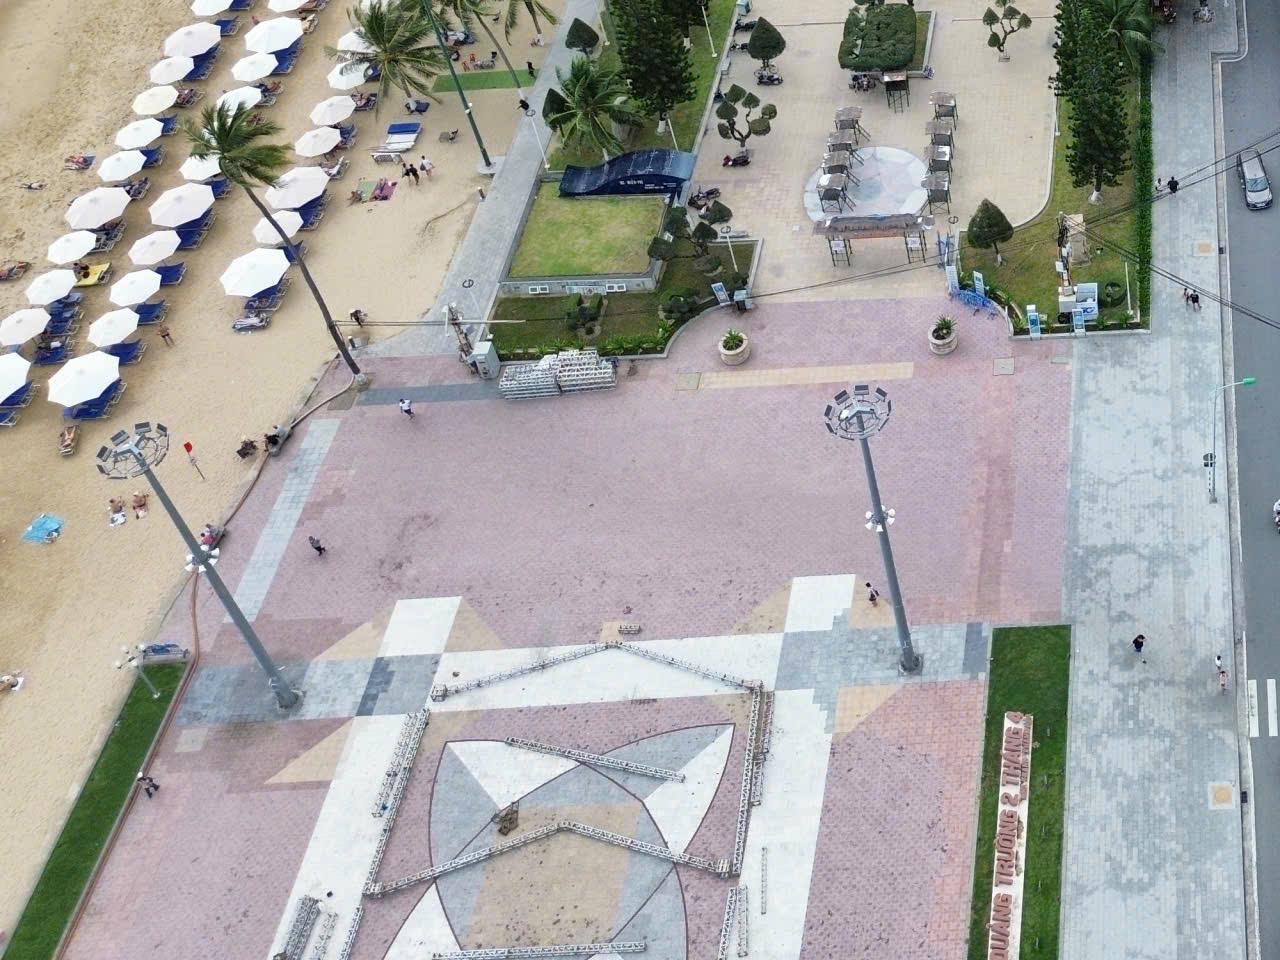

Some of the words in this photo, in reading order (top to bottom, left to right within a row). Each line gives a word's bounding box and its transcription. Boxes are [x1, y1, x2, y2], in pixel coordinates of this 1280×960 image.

[1004, 711, 1024, 724] 4
[1001, 726, 1022, 787] THÁNG
[1000, 792, 1019, 807] 2
